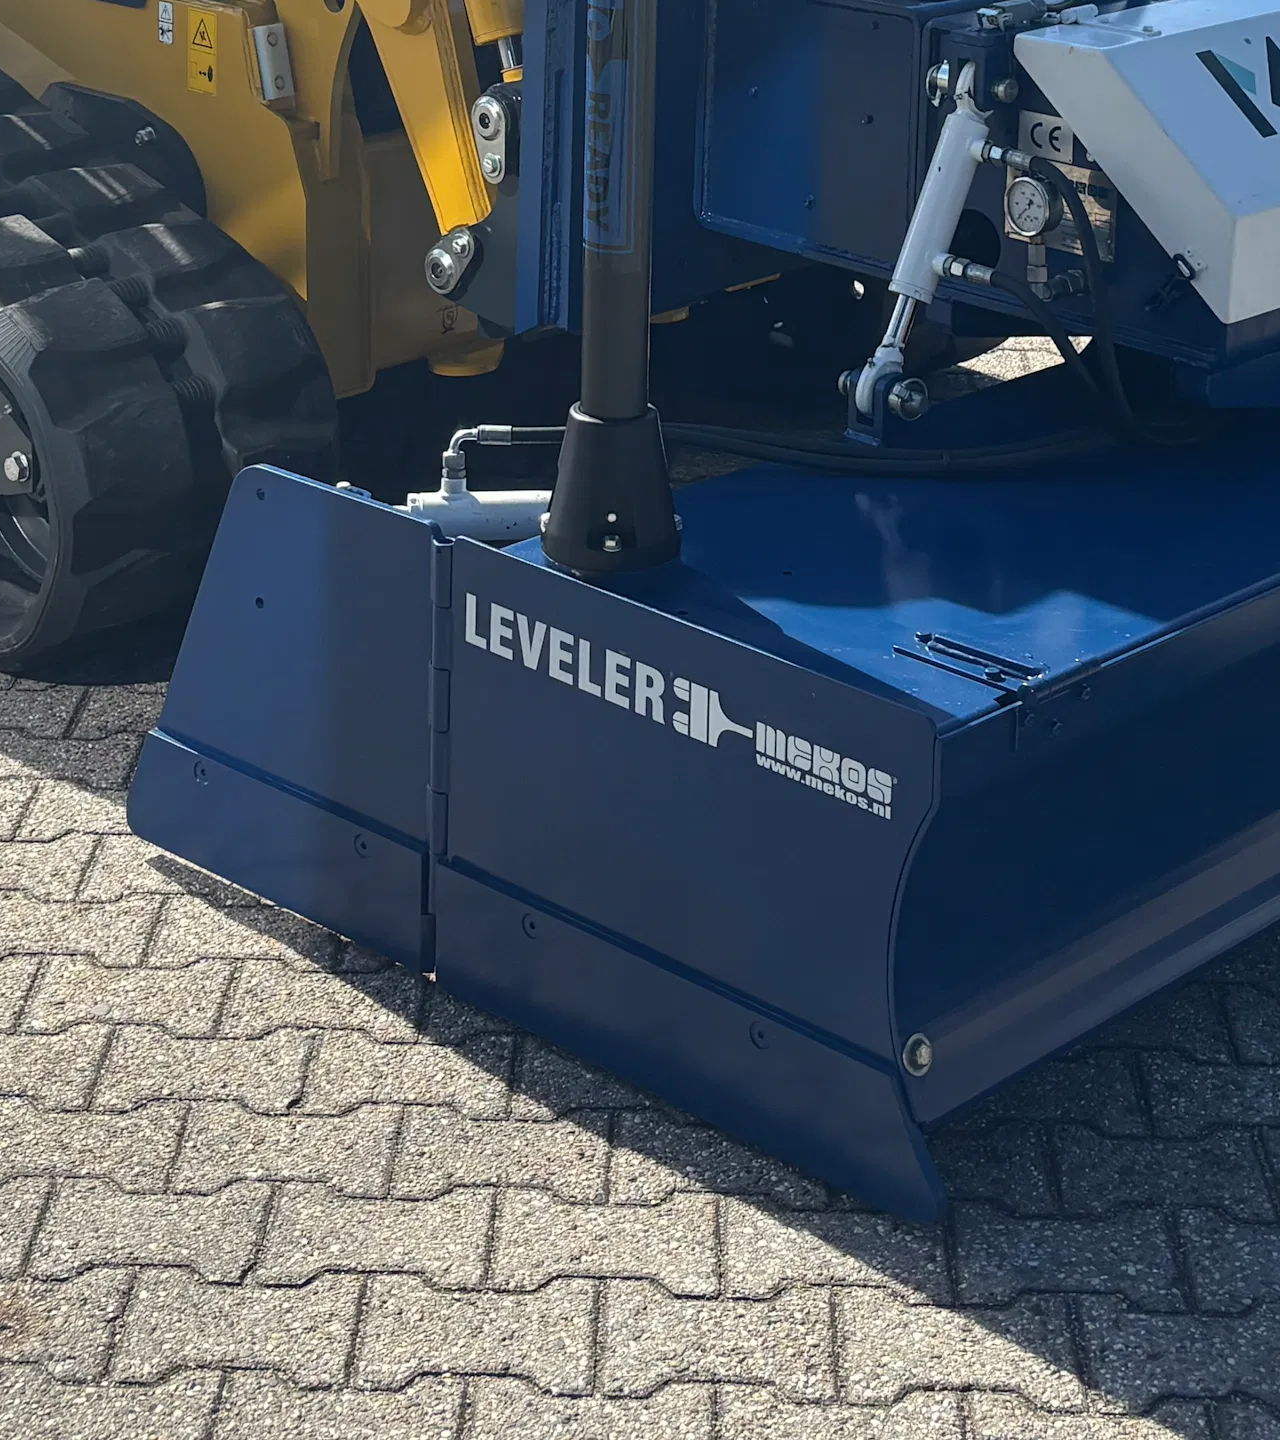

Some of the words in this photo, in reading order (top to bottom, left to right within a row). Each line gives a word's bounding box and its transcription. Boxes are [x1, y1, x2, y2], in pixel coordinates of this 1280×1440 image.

[587, 90, 612, 233] READY
[1030, 122, 1062, 153] CE
[465, 592, 665, 725] LEVELER
[756, 753, 892, 820] www.mekos.nl
